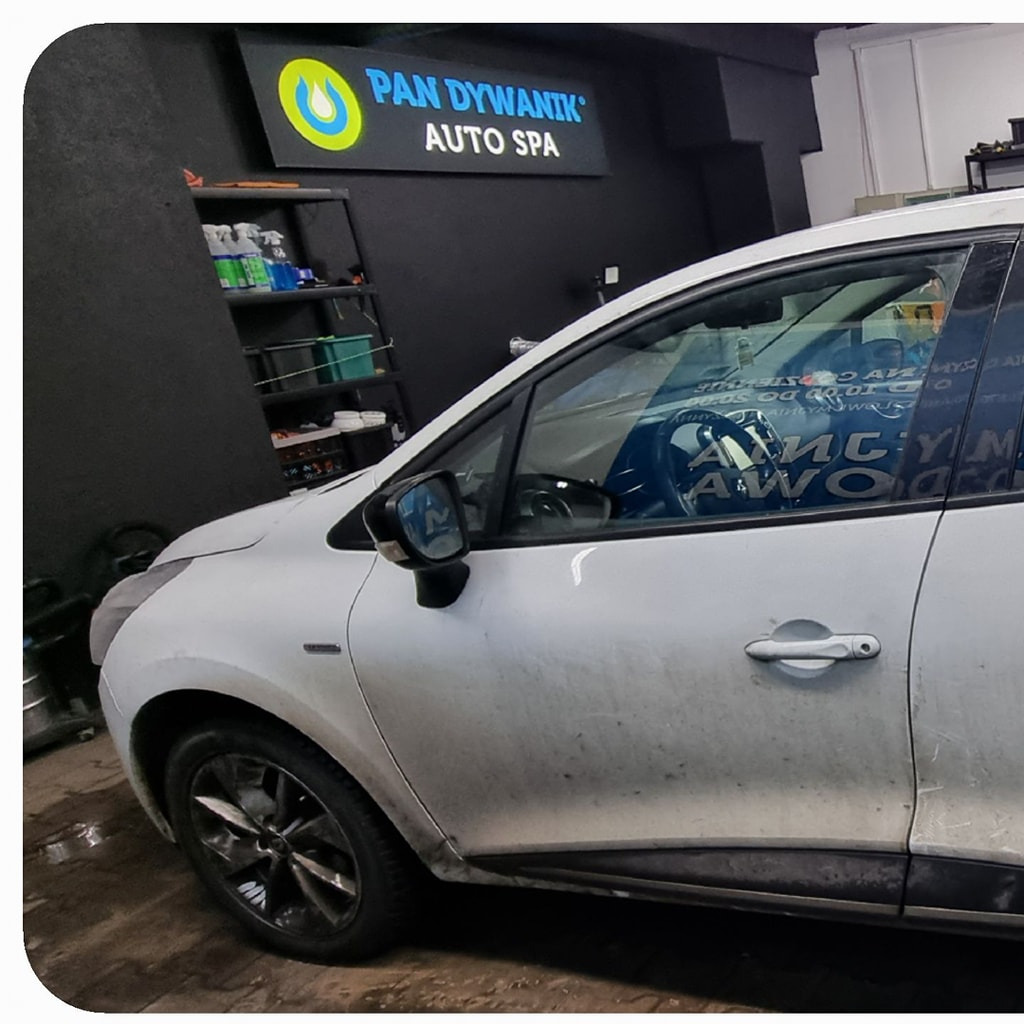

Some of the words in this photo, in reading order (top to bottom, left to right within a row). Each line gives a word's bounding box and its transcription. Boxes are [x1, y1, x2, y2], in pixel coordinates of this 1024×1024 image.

[365, 67, 441, 109] PAN
[443, 77, 583, 123] DYWANIK
[425, 122, 505, 156] AUTO
[511, 129, 561, 158] SPA
